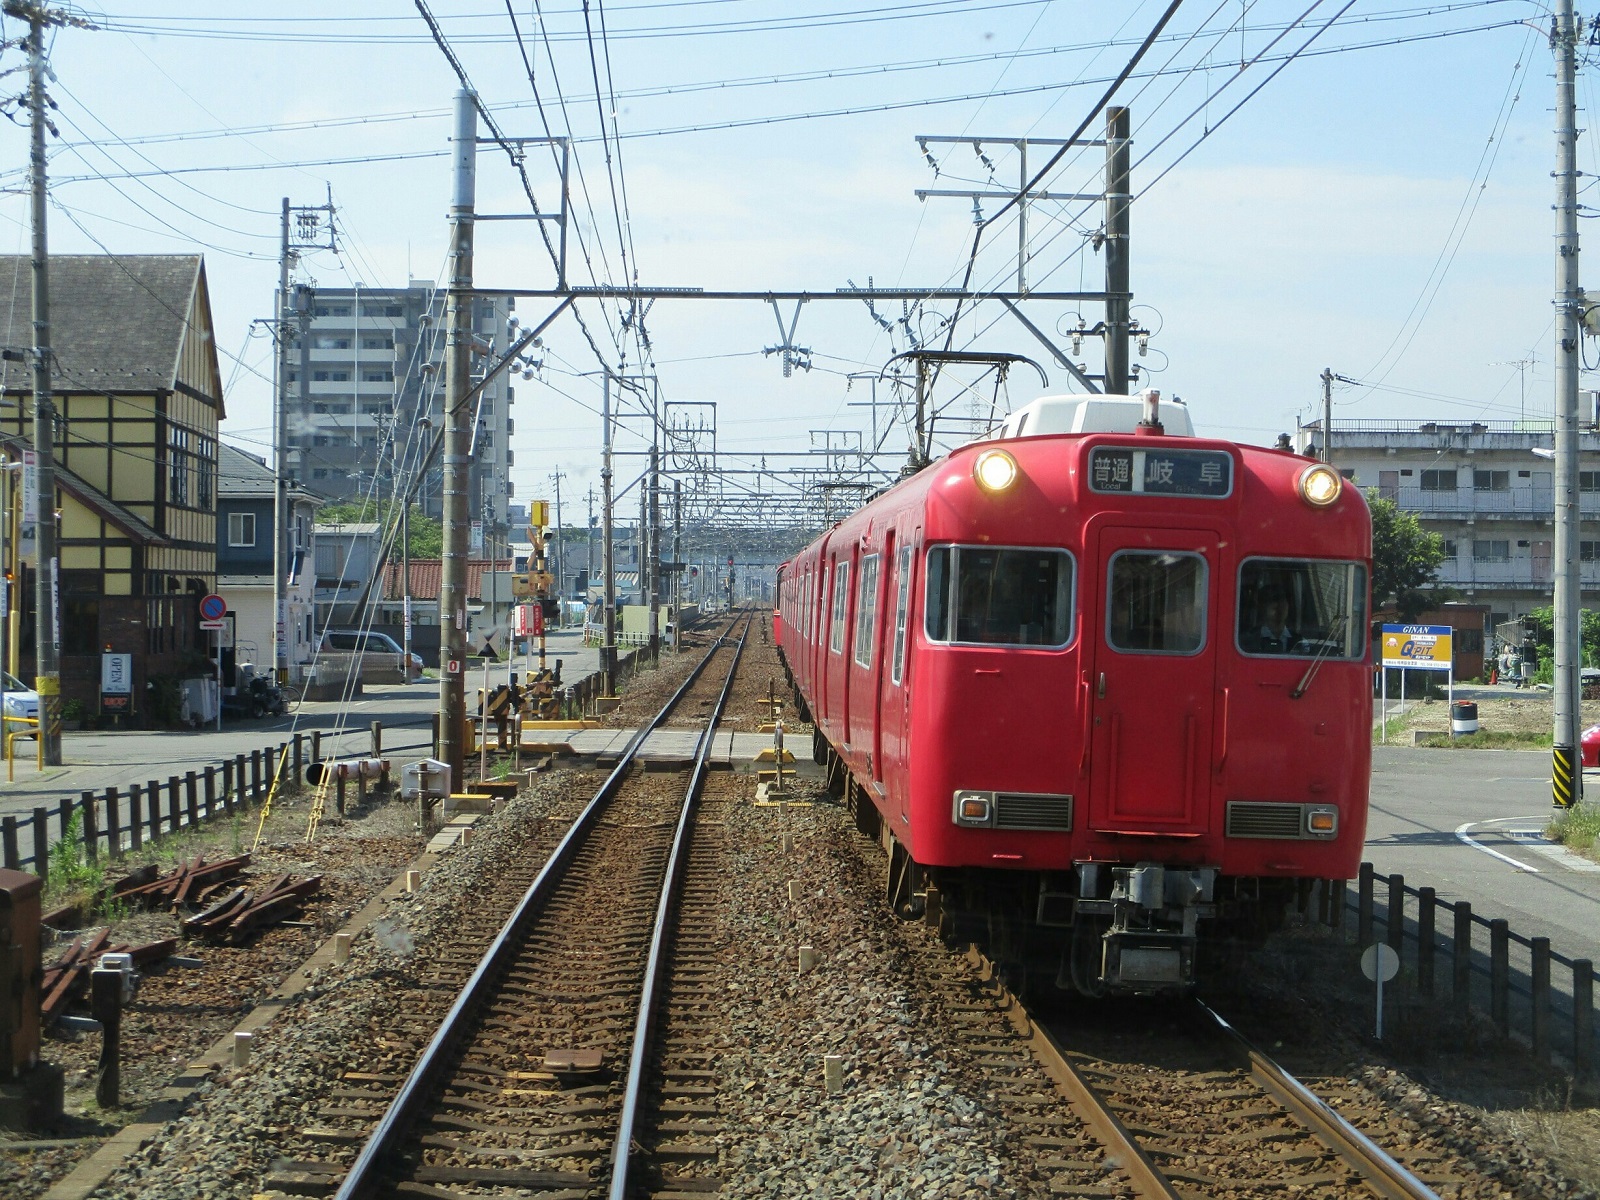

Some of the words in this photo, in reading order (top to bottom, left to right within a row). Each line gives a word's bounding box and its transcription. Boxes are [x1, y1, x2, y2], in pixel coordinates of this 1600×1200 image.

[1095, 457, 1129, 483] 普通
[1149, 459, 1223, 487] 岐阜
[1100, 482, 1121, 490] Local
[1402, 626, 1430, 634] GINAN
[111, 657, 123, 683] OPEN
